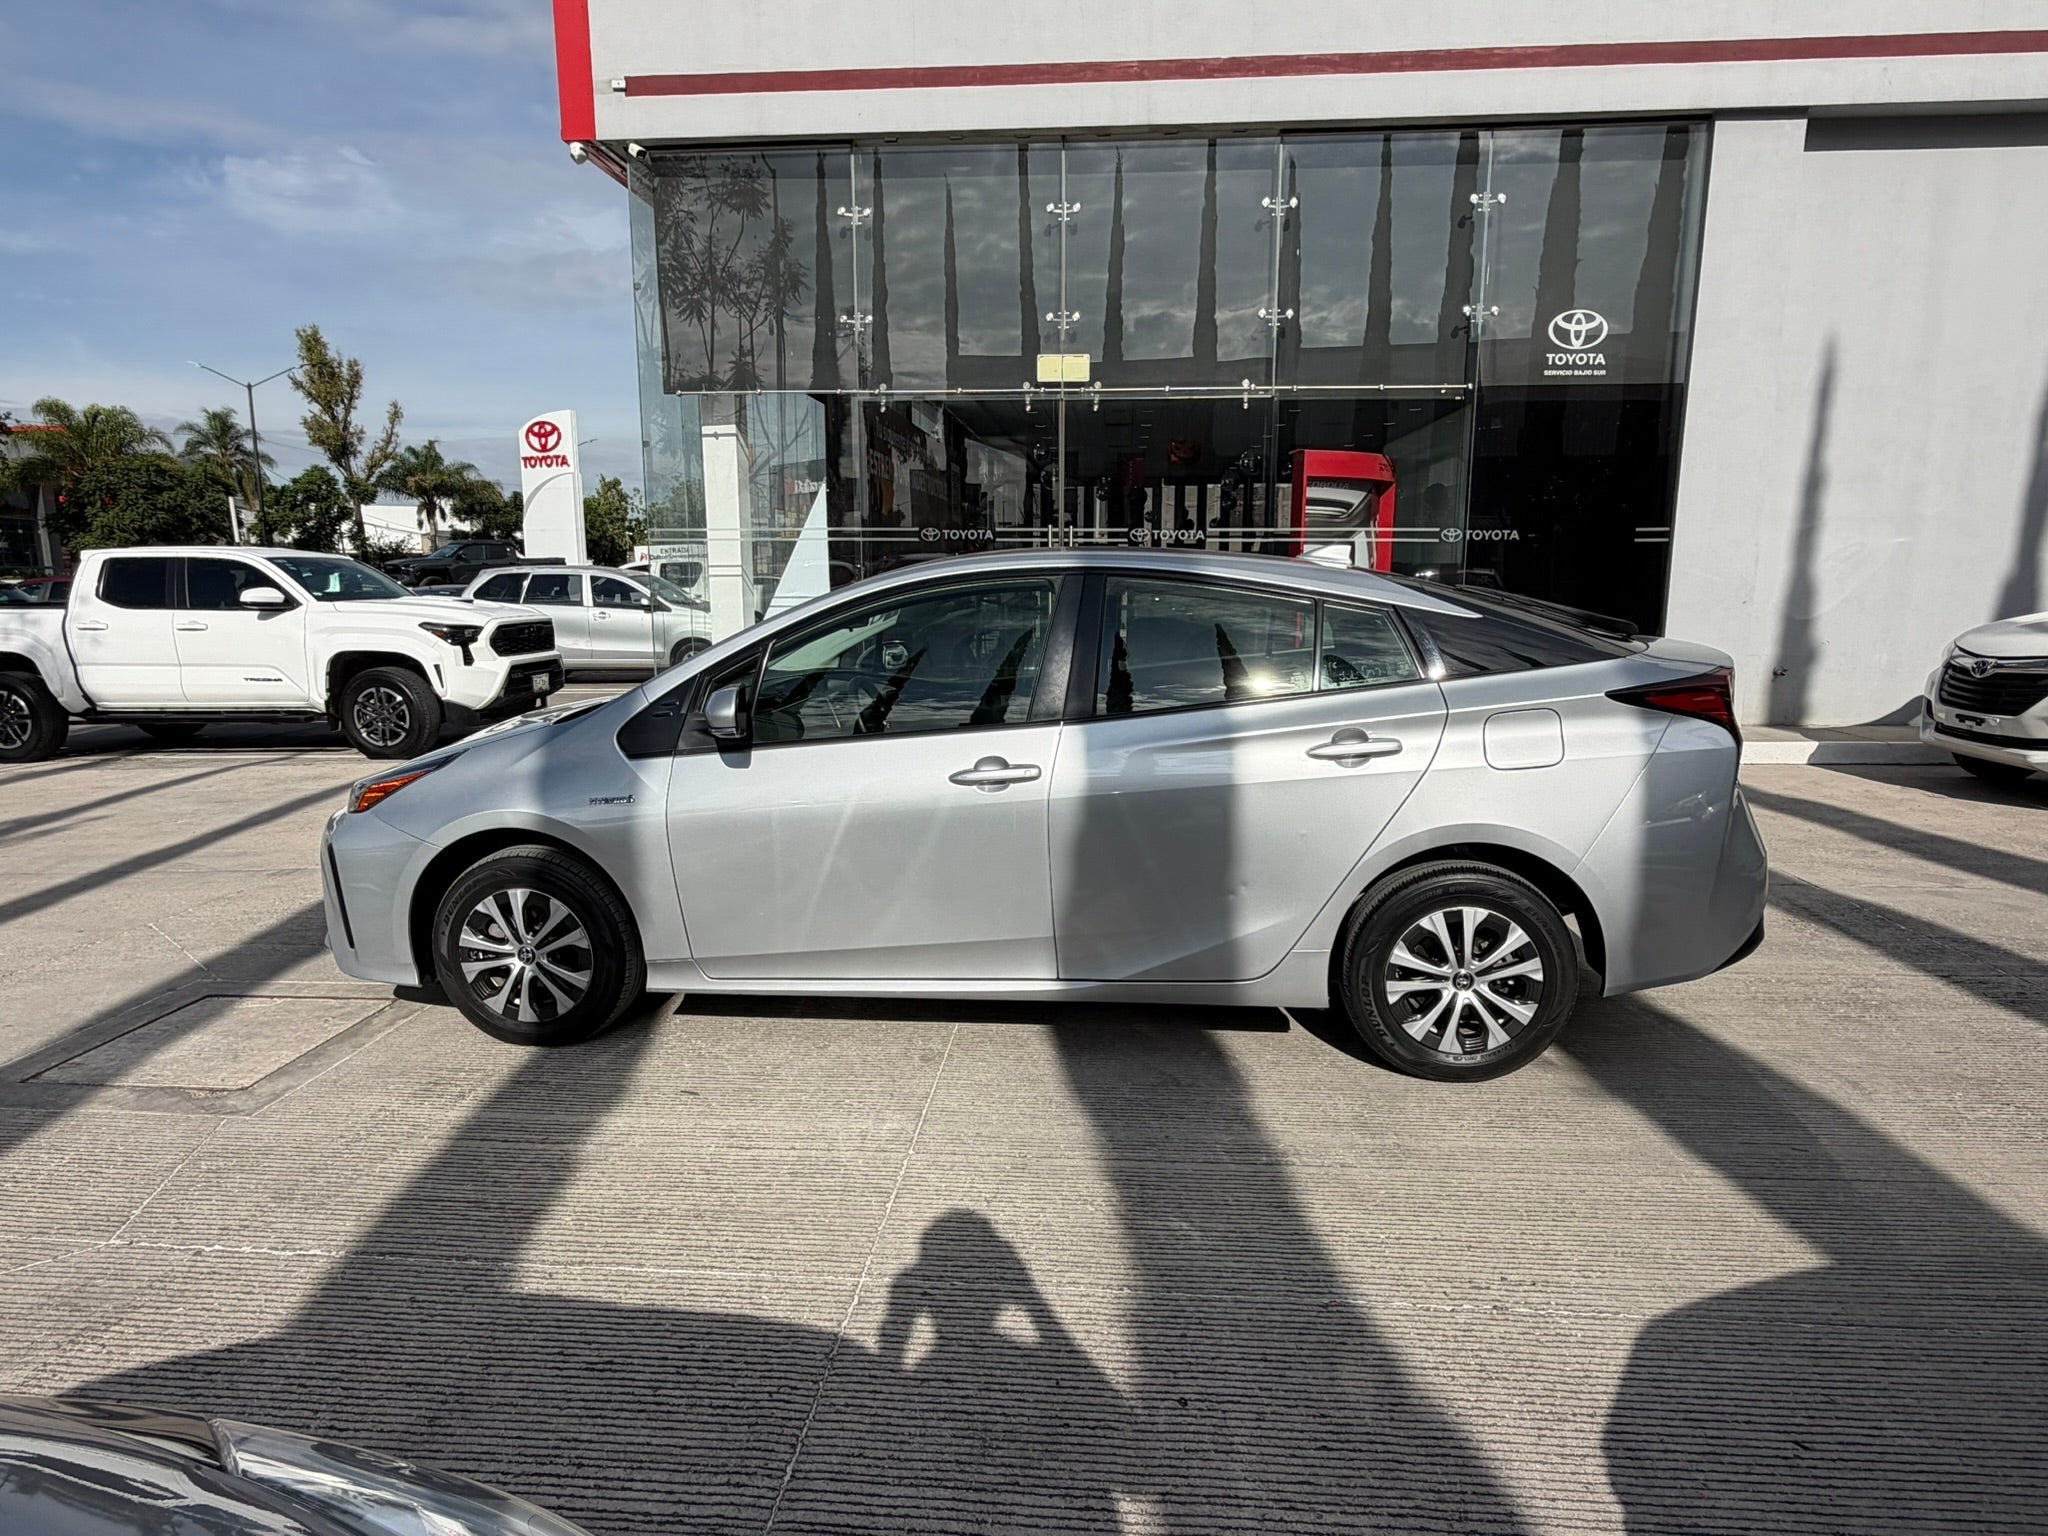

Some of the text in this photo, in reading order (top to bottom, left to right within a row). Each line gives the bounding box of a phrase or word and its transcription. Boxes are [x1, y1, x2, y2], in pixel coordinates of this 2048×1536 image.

[1546, 353, 1606, 365] TOYOTA
[521, 455, 570, 469] TOYOTA
[942, 530, 994, 540] TOYOTA
[1152, 530, 1205, 541] TOYOTA
[1465, 529, 1520, 541] TOYOTA
